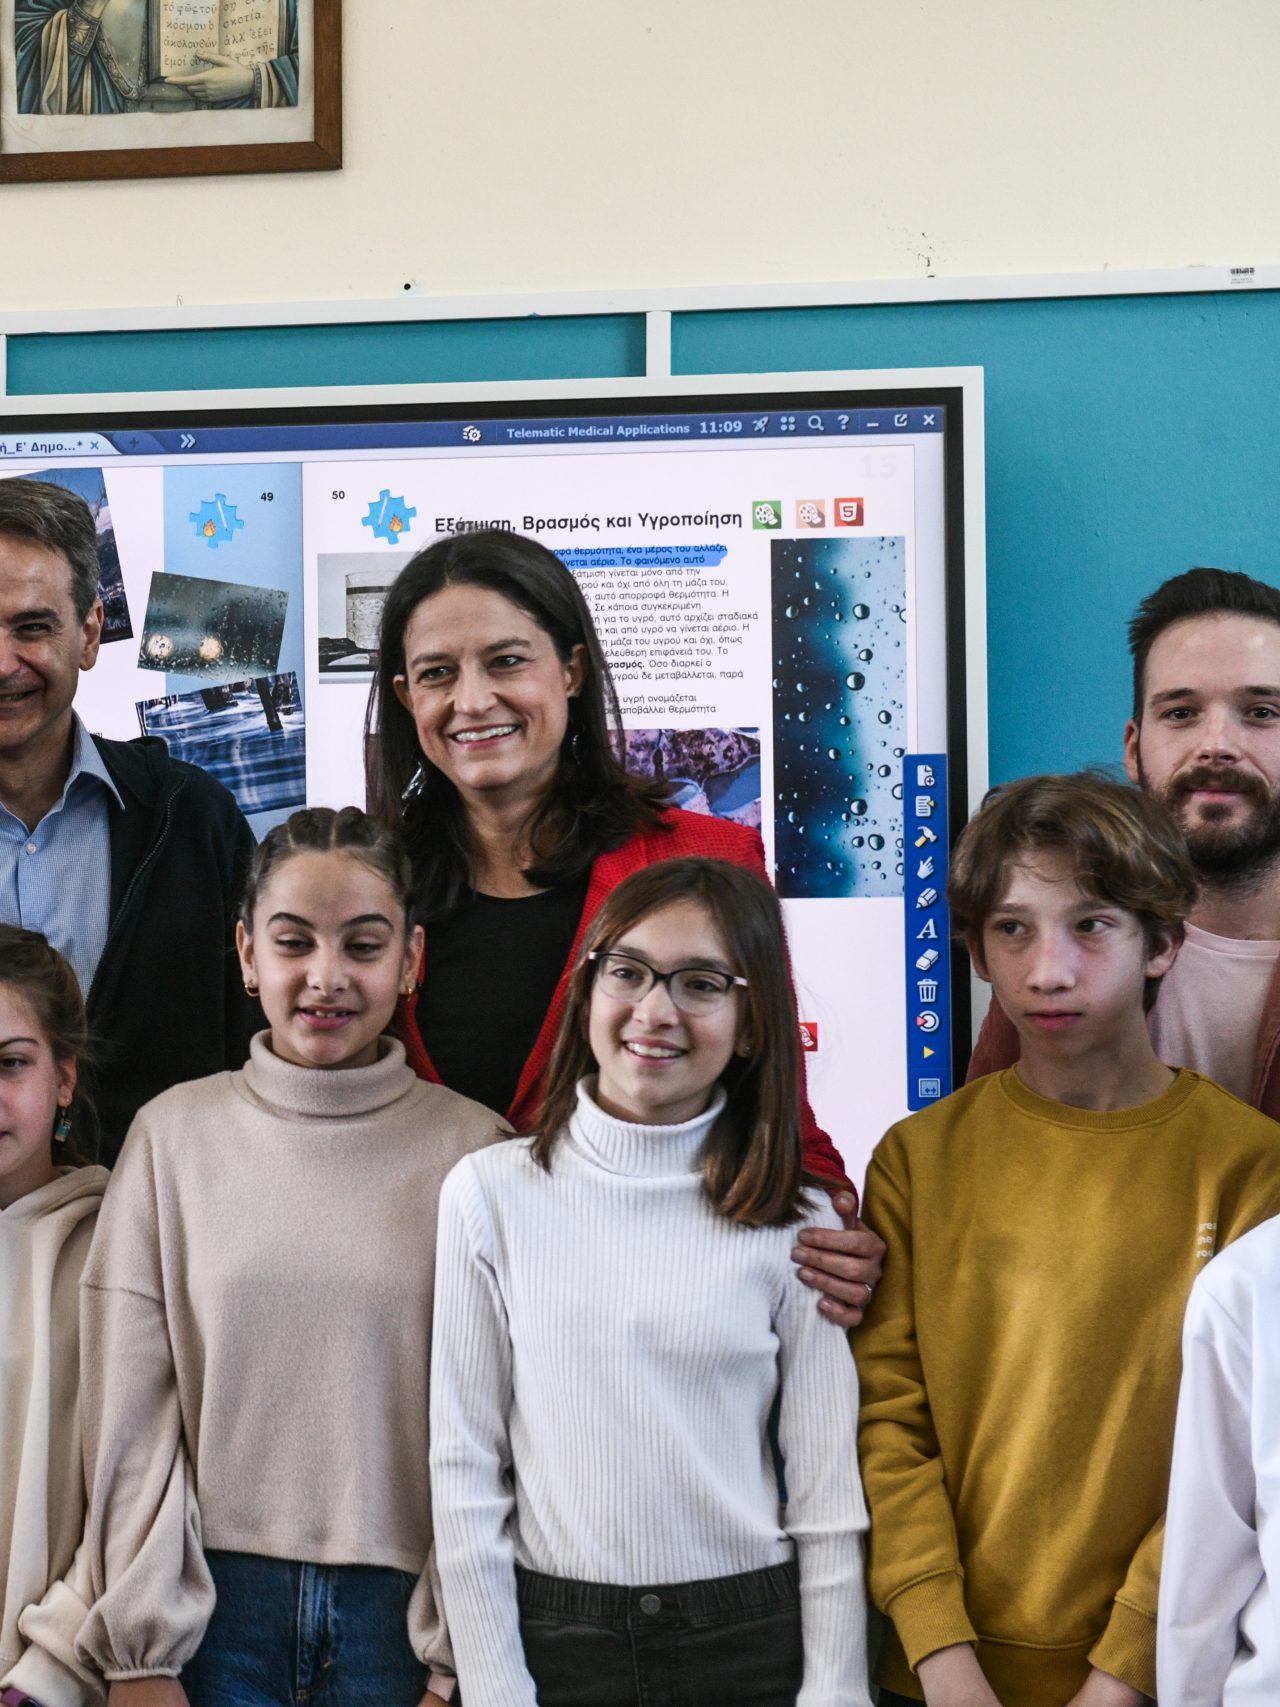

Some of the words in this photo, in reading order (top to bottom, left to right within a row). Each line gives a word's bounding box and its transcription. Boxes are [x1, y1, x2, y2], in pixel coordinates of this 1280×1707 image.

[506, 427, 565, 438] Telematic
[568, 425, 615, 436] Medical
[617, 422, 690, 437] Applications
[700, 420, 743, 434] 11:09
[260, 491, 274, 502] 49
[332, 490, 345, 500] 50
[523, 514, 600, 533] Βρασμός
[606, 515, 632, 529] και
[638, 511, 742, 530] Υγροποίηση
[574, 546, 624, 557] θερμότητα,
[626, 545, 642, 554] ένα
[645, 545, 672, 555] μέρος
[675, 545, 690, 553] του
[693, 544, 728, 554] αλλάζει
[563, 558, 588, 567] ίνεται
[620, 556, 632, 566] Το
[634, 555, 681, 566] φαινόμενο
[683, 555, 706, 565] αυτό
[572, 569, 606, 580] ξάτμιση
[608, 568, 639, 578] γίνεται
[641, 567, 664, 578] μόνο
[665, 567, 683, 578] από
[686, 567, 701, 577] την
[601, 581, 615, 589] και
[617, 580, 631, 590] όχι
[633, 579, 651, 589] από
[653, 578, 670, 589] όλη
[672, 578, 683, 588] τη
[685, 577, 707, 588] μάζα
[594, 592, 616, 601] αυτό
[619, 591, 666, 602] απορροφά
[594, 603, 606, 612] Σε
[608, 602, 638, 611] κάποια
[641, 602, 702, 613] συγκεκριμένη
[603, 615, 617, 625] για
[619, 615, 629, 624] το
[660, 613, 681, 623] αυτό
[683, 612, 714, 623] αρχίζει
[717, 611, 759, 621] σταδιακά
[605, 626, 618, 635] και
[620, 626, 638, 636] από
[641, 625, 664, 636] υγρό
[666, 626, 677, 634] να
[679, 624, 710, 635] γίνεται
[610, 637, 632, 648] μάζα
[635, 637, 650, 646] του
[653, 635, 681, 646] υγρού
[683, 636, 697, 645] και
[718, 635, 743, 645] όπως
[604, 648, 647, 658] ελεύθερη
[649, 646, 693, 658] επιφάνειά
[717, 646, 729, 656] Το
[607, 660, 645, 670] ρασμός.
[648, 659, 669, 669] Όσο
[671, 658, 703, 669] διαρκεί
[641, 671, 653, 680] δε
[655, 669, 717, 681] μεταβάλλεται,
[719, 670, 744, 680] παρά
[622, 695, 645, 704] υγρή
[647, 693, 697, 704] ονομάζεται
[619, 704, 666, 715] αποβάλλει
[668, 703, 717, 714] θερμότητα
